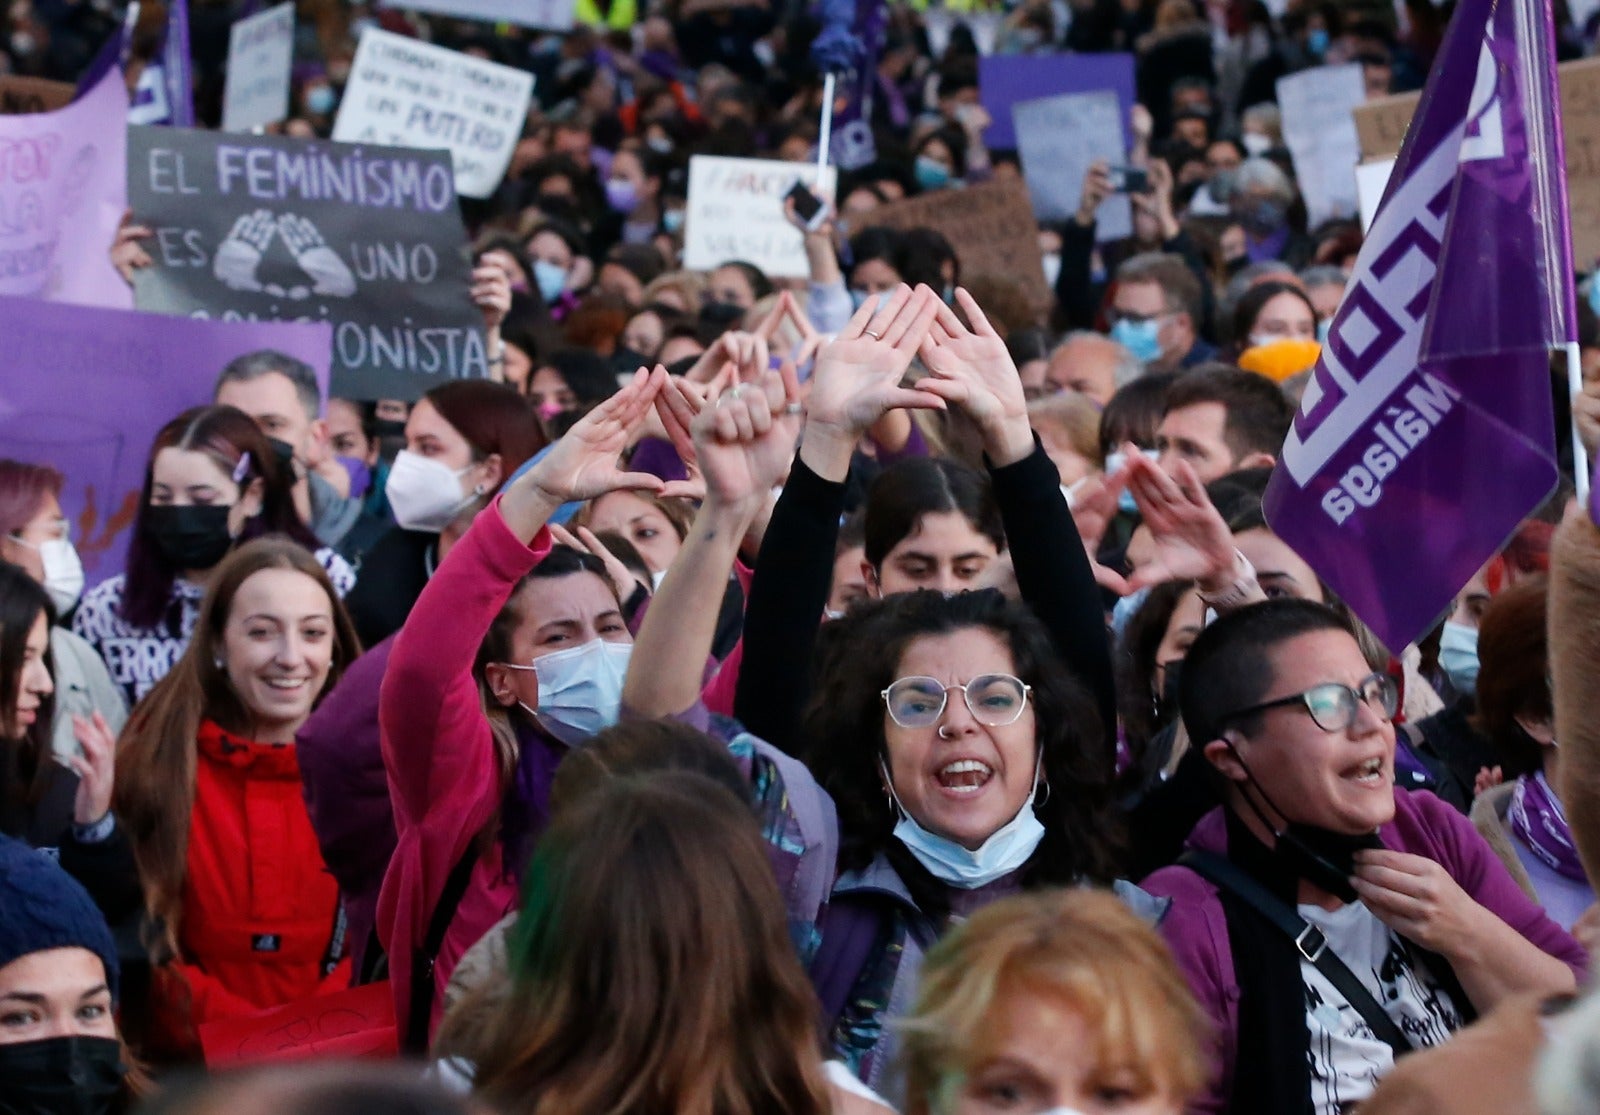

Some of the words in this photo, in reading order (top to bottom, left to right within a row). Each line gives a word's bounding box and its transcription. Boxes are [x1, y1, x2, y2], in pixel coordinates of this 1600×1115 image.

[405, 101, 506, 152] PUTERO
[149, 148, 199, 195] EL
[157, 226, 207, 267] ES
[354, 239, 438, 284] UNO
